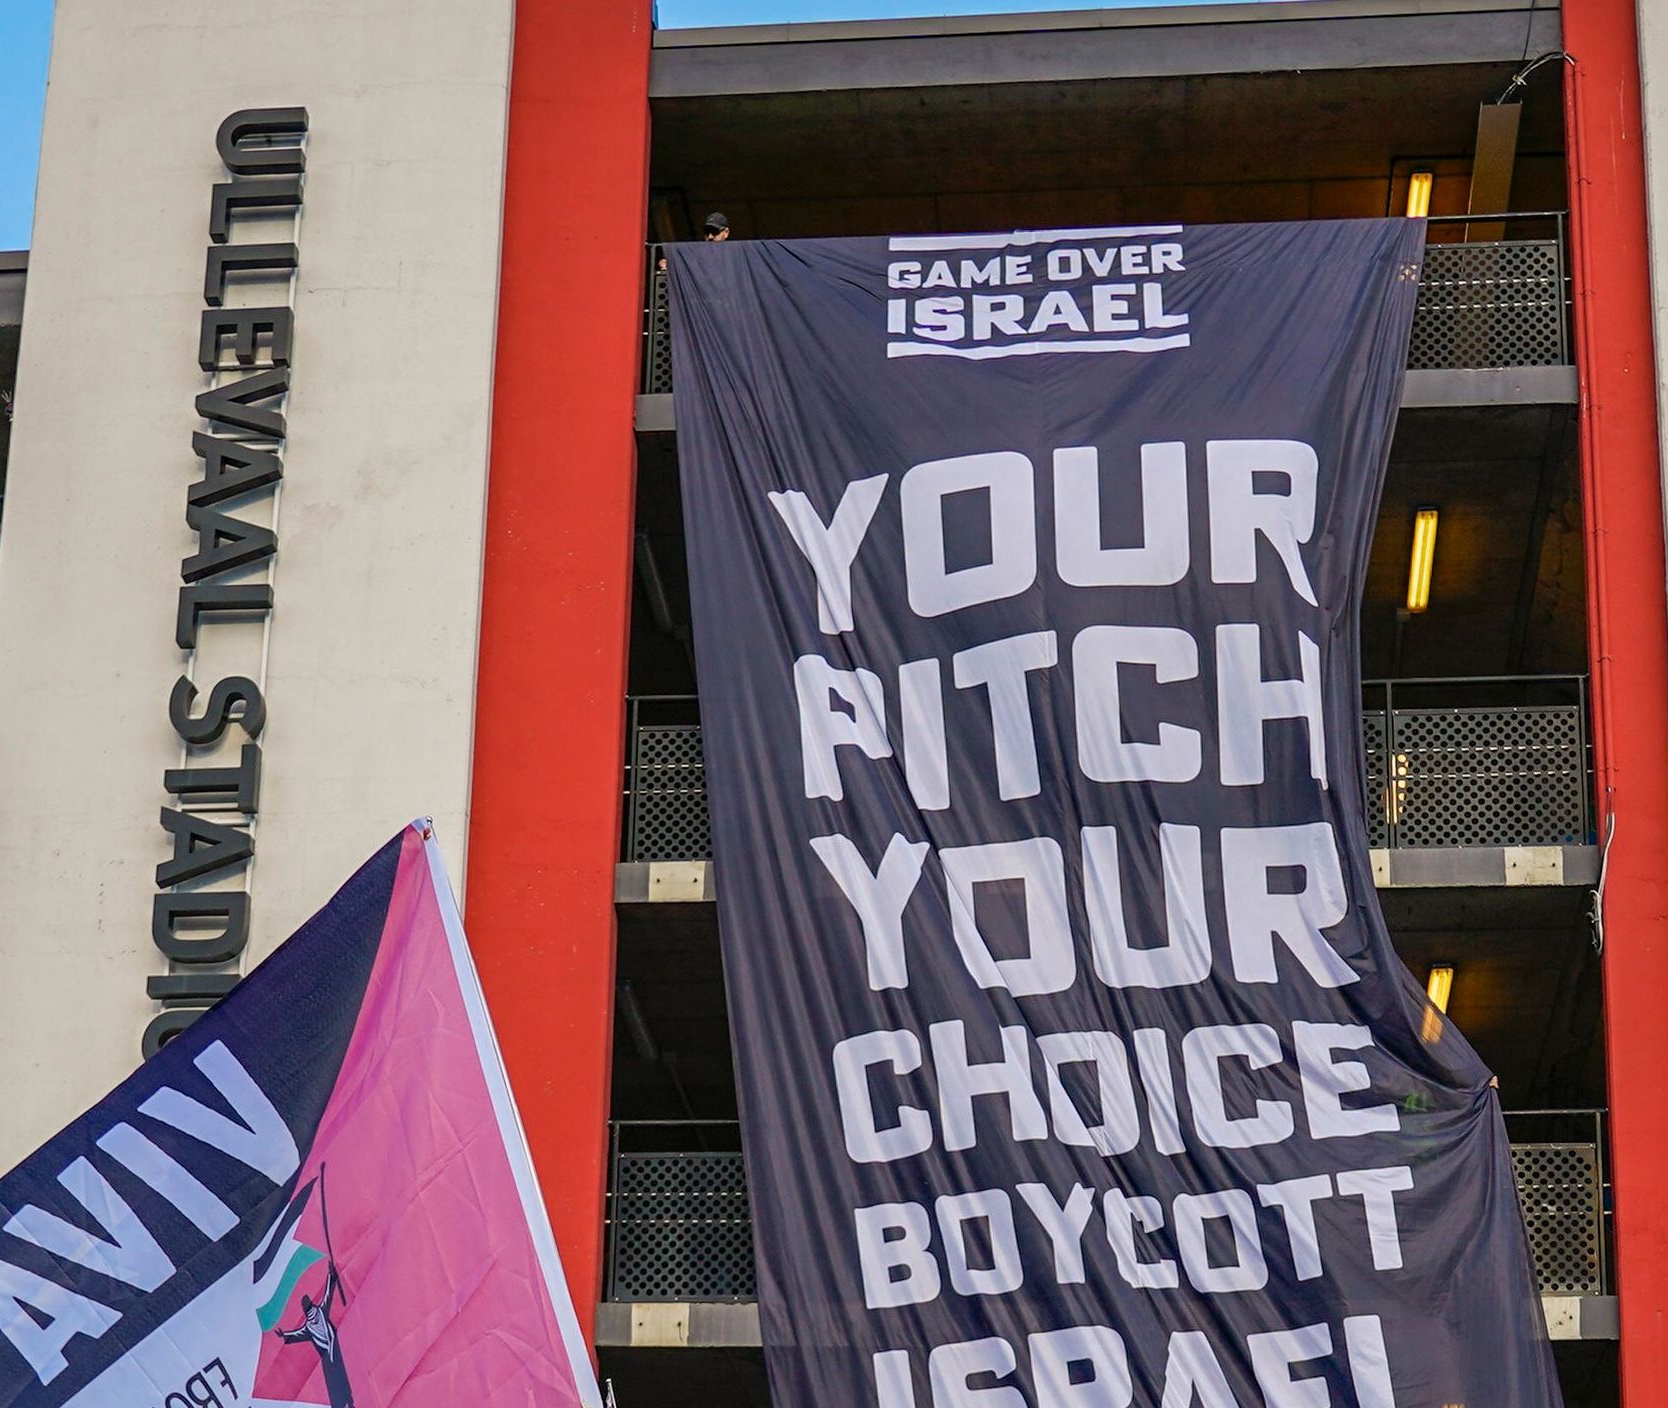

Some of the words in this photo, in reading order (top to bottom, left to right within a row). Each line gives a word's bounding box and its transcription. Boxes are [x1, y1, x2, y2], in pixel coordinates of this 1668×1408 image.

[887, 254, 1033, 289] GAME
[1047, 243, 1186, 281] OVER
[887, 282, 1189, 342] ISRAEL
[174, 106, 309, 649] ULLEVAAL
[768, 440, 1319, 635] YOUR
[794, 624, 1329, 811] PITCH
[810, 822, 1361, 998] YOUR
[833, 1020, 1401, 1163] CHOICE
[854, 1166, 1415, 1310] BOYCOTT
